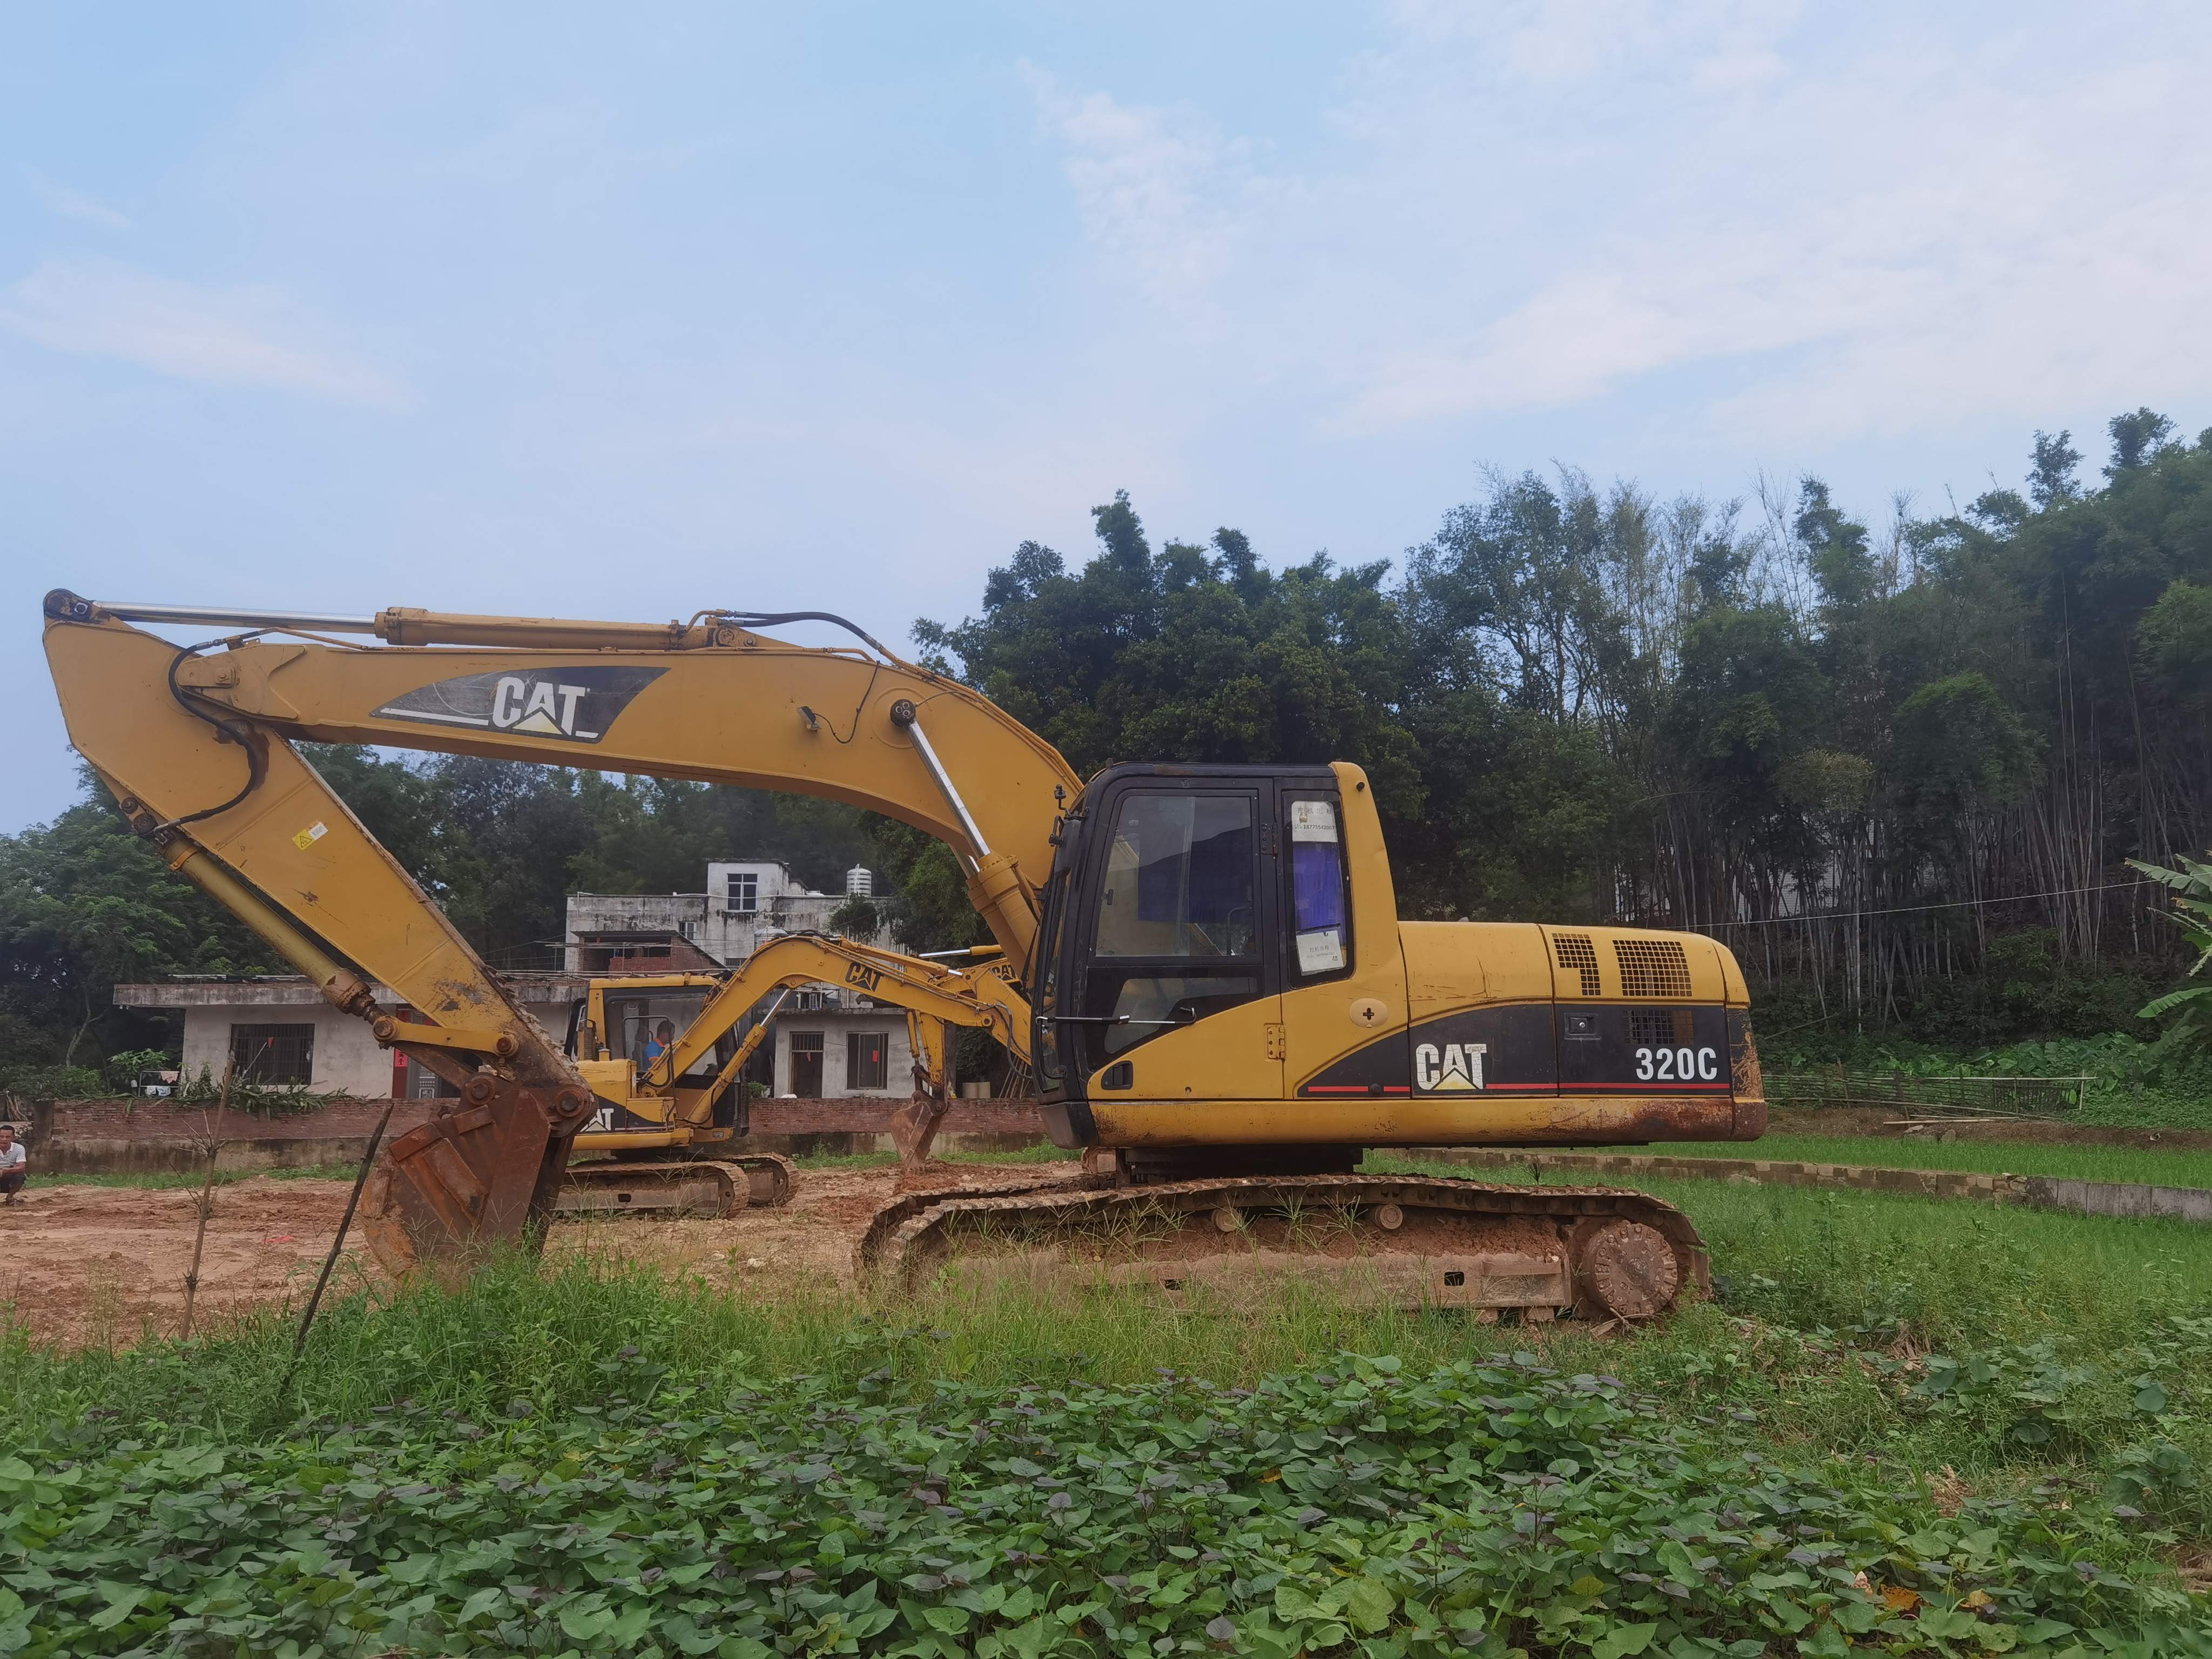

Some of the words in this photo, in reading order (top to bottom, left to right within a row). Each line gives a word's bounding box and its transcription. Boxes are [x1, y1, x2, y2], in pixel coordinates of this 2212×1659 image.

[492, 677, 586, 736] CAT
[845, 961, 885, 992] CAT
[1415, 1043, 1487, 1090] CAT
[1636, 1047, 1717, 1080] 320C
[579, 1108, 614, 1132] AT
